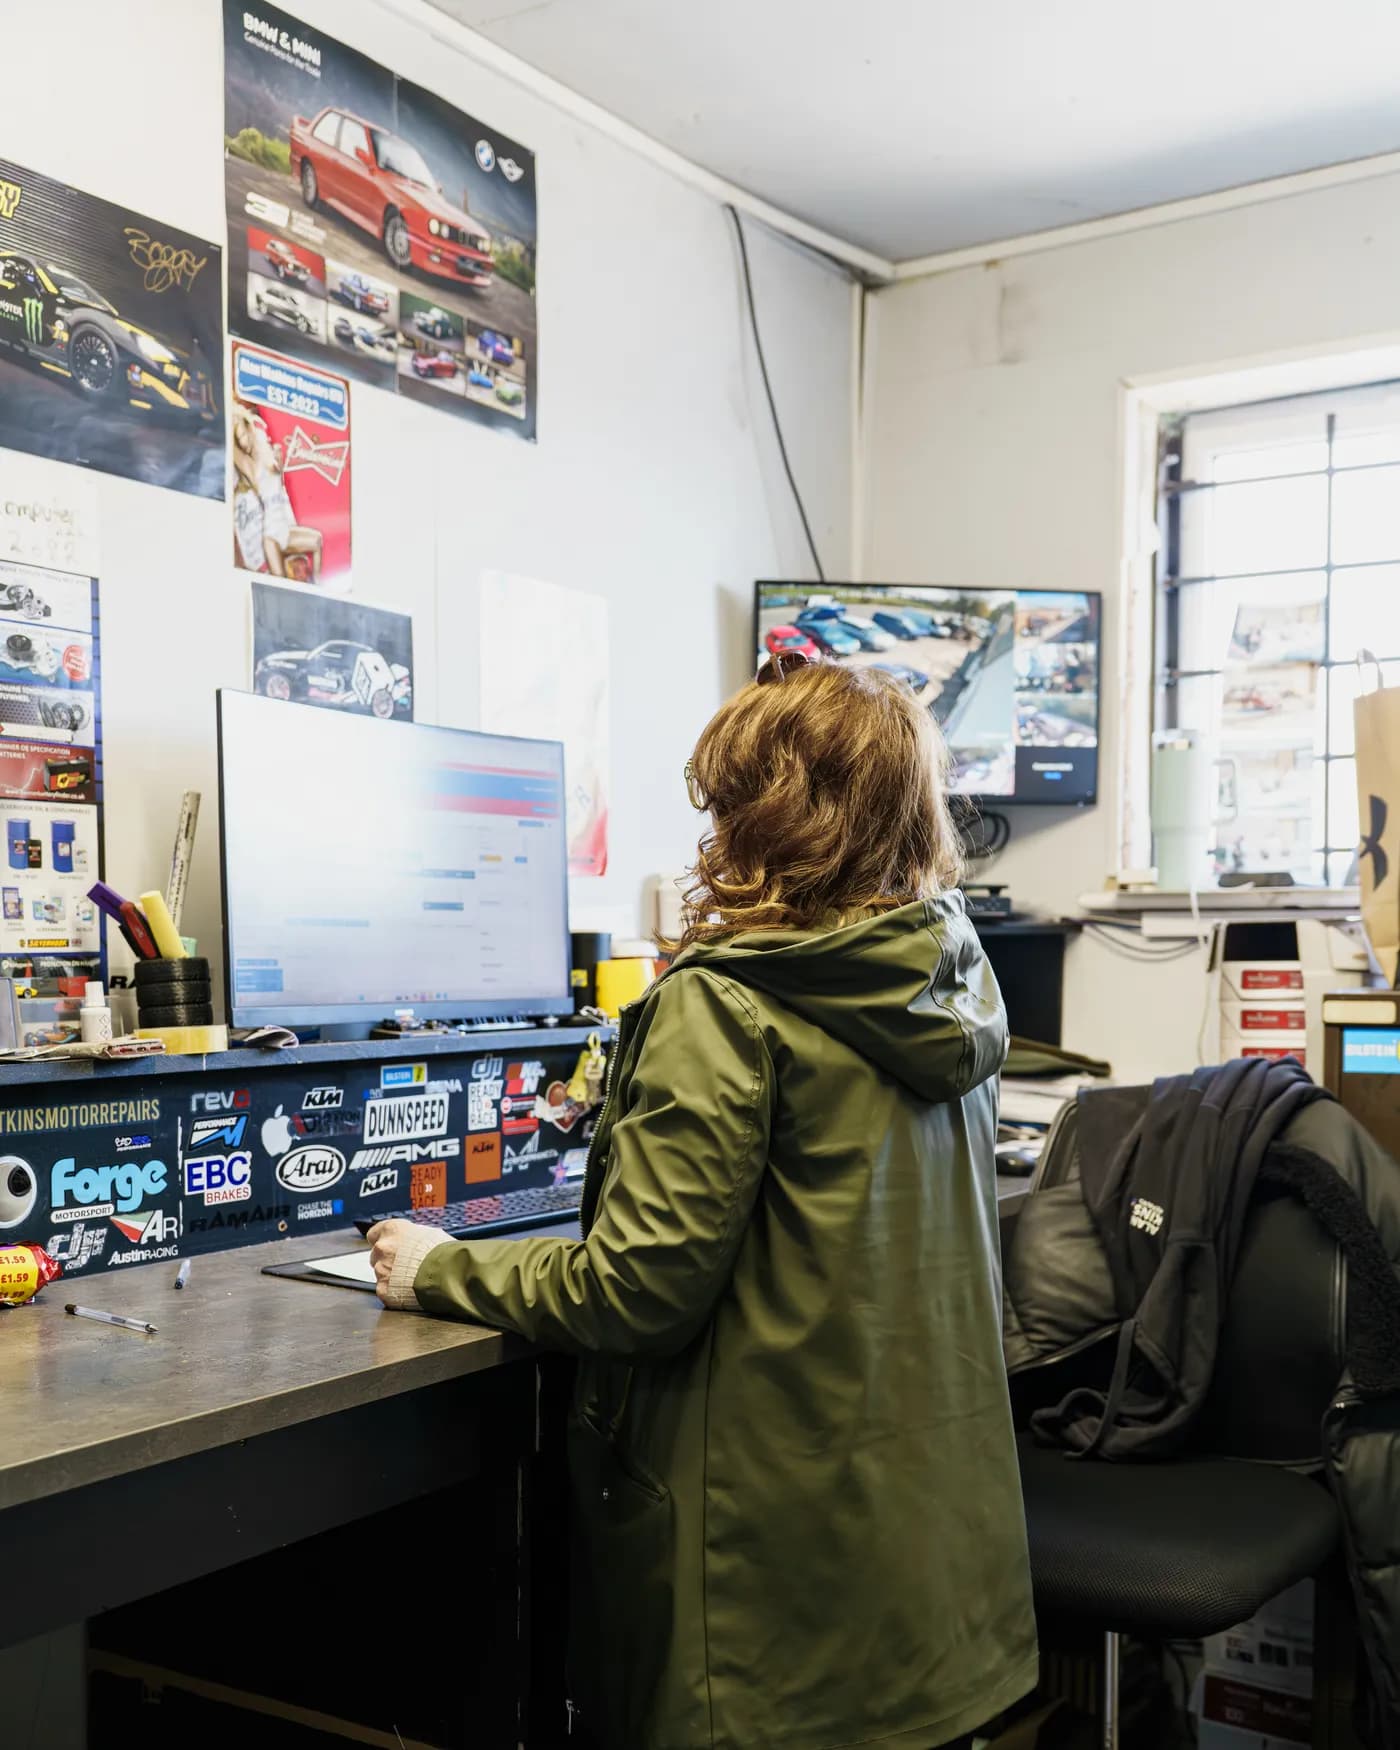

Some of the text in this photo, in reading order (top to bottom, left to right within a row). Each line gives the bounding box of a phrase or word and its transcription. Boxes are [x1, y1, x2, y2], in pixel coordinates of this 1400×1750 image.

[243, 12, 278, 43] BMW
[279, 31, 292, 51] &
[292, 37, 321, 67] MINI
[1345, 1043, 1396, 1057] BILSTEIN
[304, 1089, 342, 1107] KTM
[368, 1099, 445, 1138] DUNNSPEED
[387, 1138, 460, 1164] AMG
[472, 1141, 494, 1154] KTM
[186, 1155, 249, 1193] EBC
[284, 1153, 335, 1179] Arai
[411, 1166, 443, 1182] READY
[362, 1172, 397, 1193] KTM
[411, 1182, 424, 1195] TO
[206, 1186, 250, 1204] BRAKES
[411, 1194, 436, 1209] RACE
[55, 1206, 111, 1220] MOTORSPORT
[297, 1206, 333, 1220] HORIZON
[1, 1272, 29, 1284] £1.59
